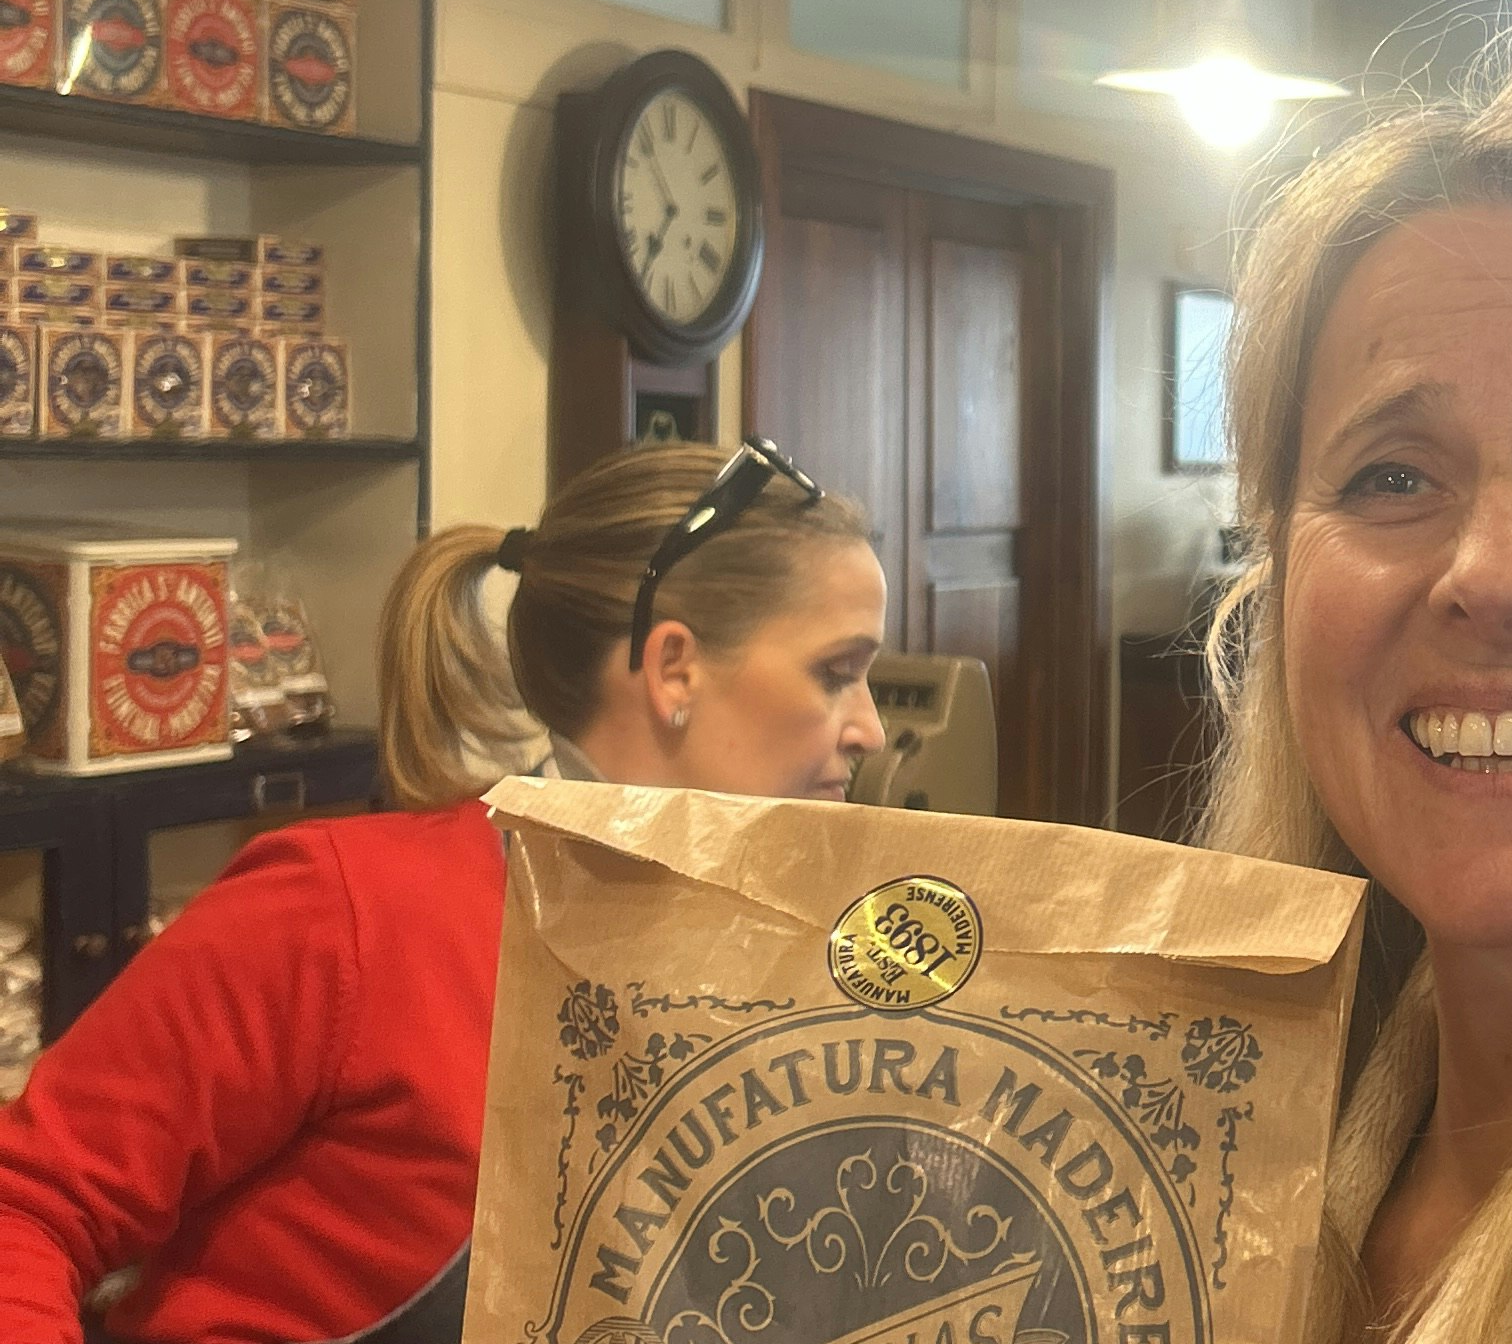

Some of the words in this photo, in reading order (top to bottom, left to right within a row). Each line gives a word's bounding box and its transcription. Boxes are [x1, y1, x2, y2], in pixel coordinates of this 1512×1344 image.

[875, 903, 957, 979] 1893
[906, 886, 972, 955] MADEIRENSE
[838, 933, 910, 1004] MANUFATURA
[589, 1038, 961, 1305] MANUFATURA
